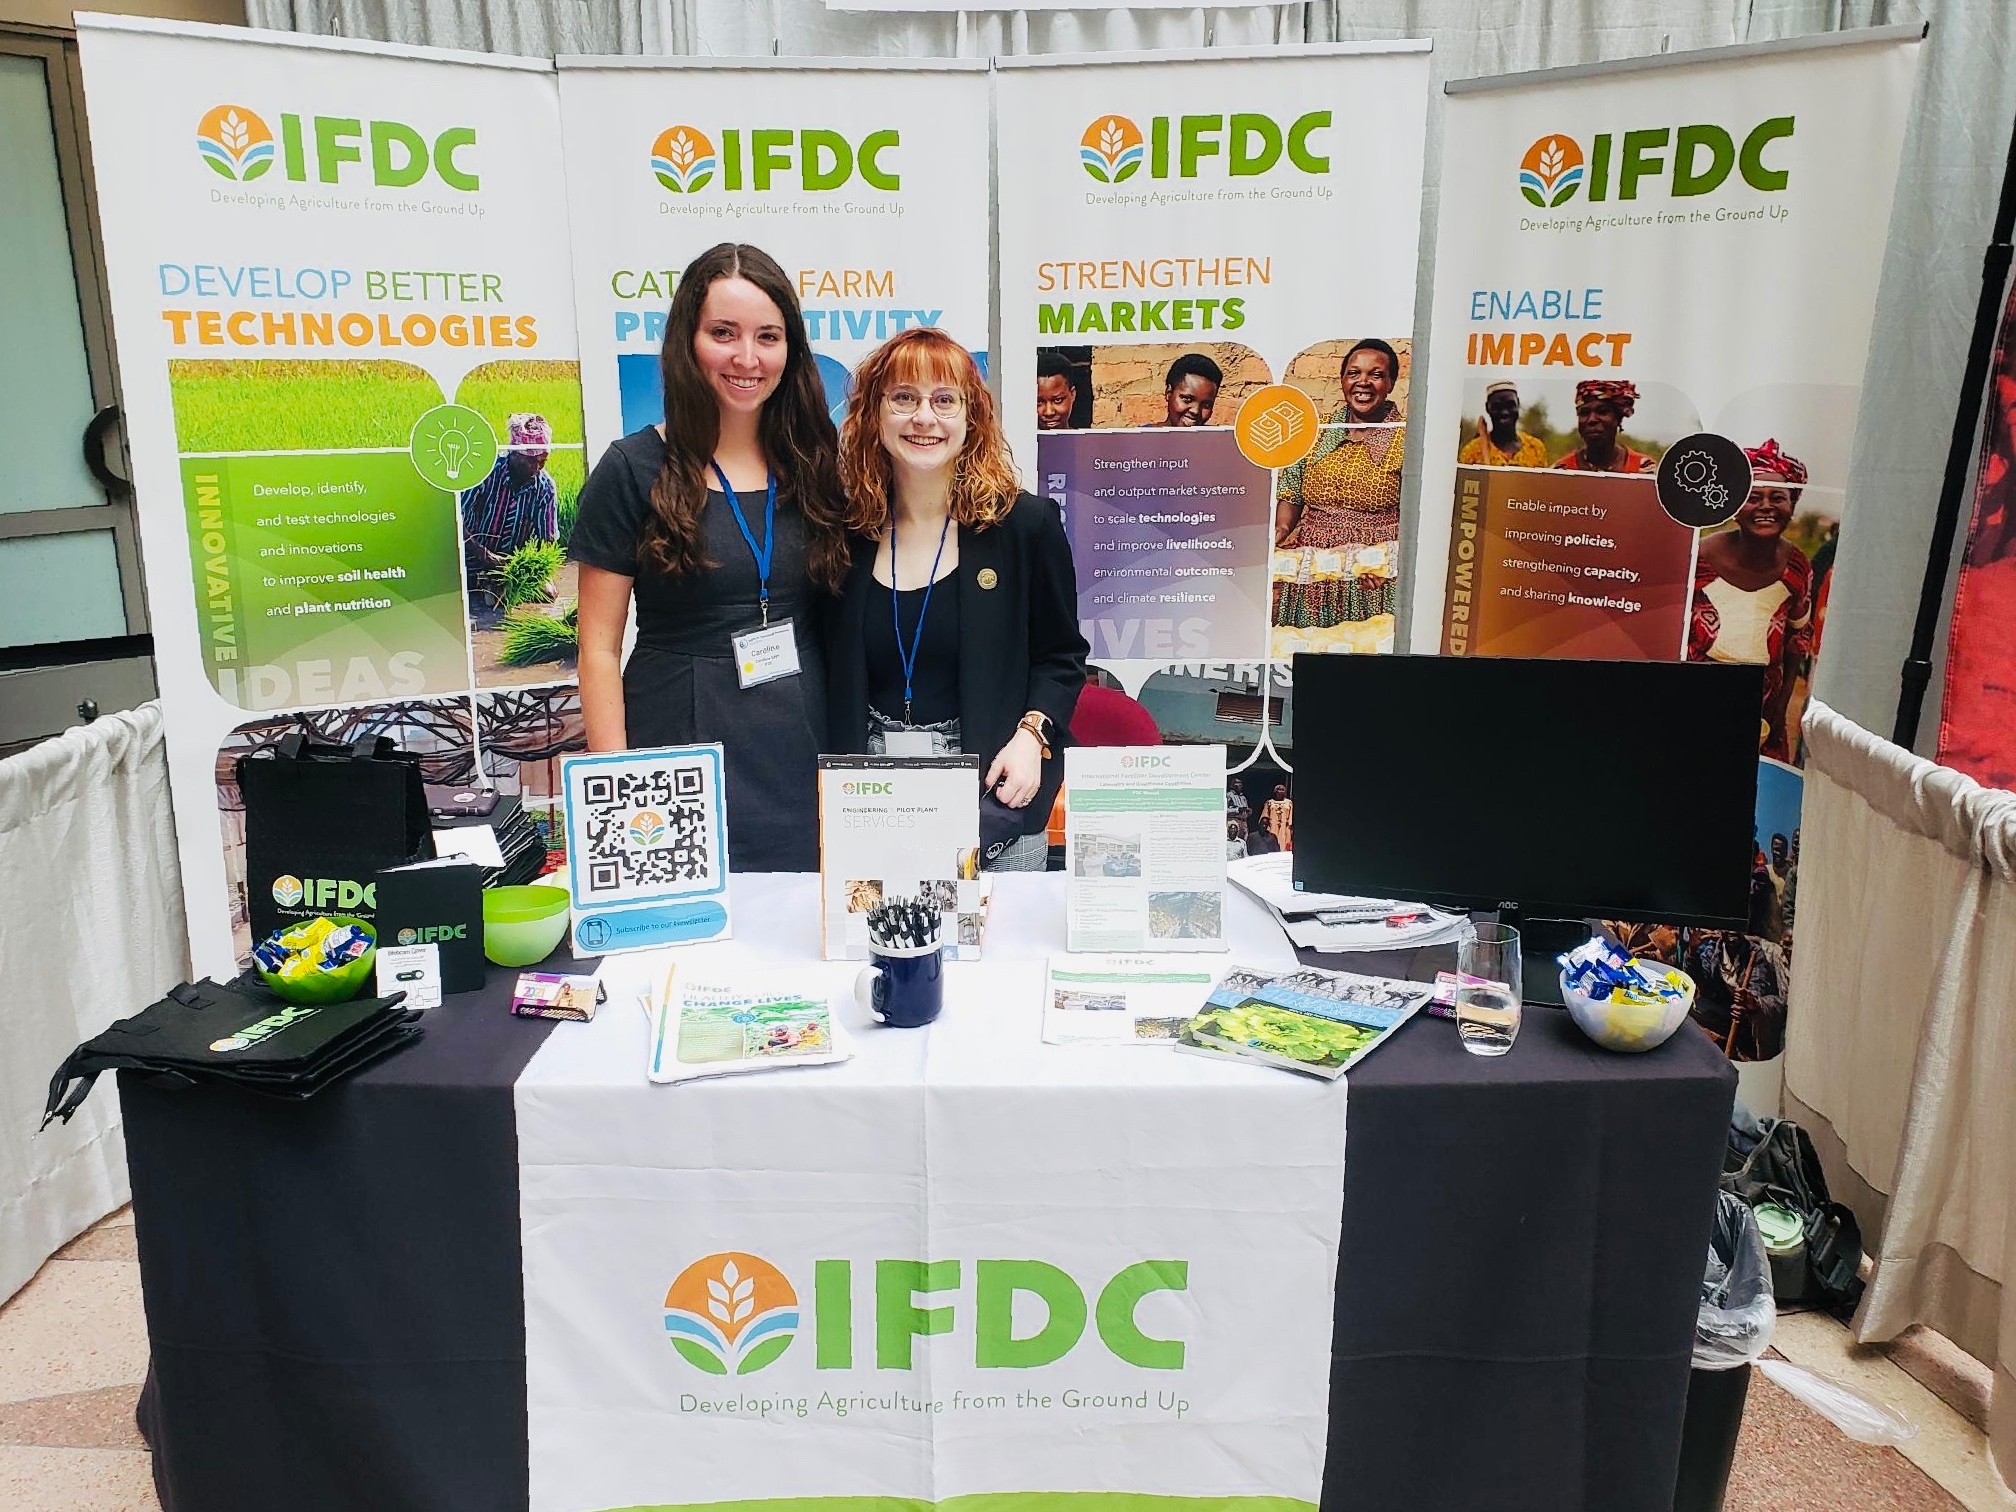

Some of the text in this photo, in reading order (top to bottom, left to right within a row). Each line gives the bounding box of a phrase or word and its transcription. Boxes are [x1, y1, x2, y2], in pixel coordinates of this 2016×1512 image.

[280, 112, 481, 192] IFDC
[1151, 110, 1333, 179] IFDC
[721, 129, 901, 191] IFDC
[1588, 115, 1796, 202] IFDC
[210, 189, 486, 220] Developing Agriculture from the Ground Up
[1085, 186, 1333, 207] Developing Agriculture from the Ground Up
[659, 202, 905, 218] Developing Agriculture from the Ground Up
[1519, 204, 1789, 233] Developing Agriculture from the Ground Up
[158, 263, 504, 302] DEVELOP BETTER
[799, 269, 895, 298] FARM
[1037, 256, 1272, 291] STRENGTHEN
[1038, 297, 1246, 334] MARKETS
[1471, 288, 1603, 321] ENABLE
[162, 309, 539, 348] TECHNOLOGIES
[1466, 331, 1632, 367] IMPACT
[1094, 457, 1189, 473] Strengthen input
[253, 479, 367, 498] Develop, identify,
[1094, 484, 1246, 499] and output market systems
[256, 508, 396, 527] and test technologies
[1094, 511, 1216, 527] to scale technologies
[1507, 498, 1607, 520] Enable impact by
[260, 541, 363, 557] and innovations
[1094, 537, 1236, 554] and improve livelihoods,
[1504, 528, 1618, 550] improving policies,
[194, 474, 239, 662] INNOVATIVE
[263, 566, 406, 589] to improve soil health
[1094, 566, 1237, 579] environmental outcomes,
[1450, 480, 1480, 656] EMPOWERED
[1502, 557, 1641, 583] strengthening capacity,
[266, 597, 392, 618] and plant nutrition
[1094, 592, 1216, 604] and climate resilience
[1500, 586, 1642, 613] and sharing knowledge
[1080, 617, 1213, 659] IVES
[751, 645, 780, 657] Caroline
[218, 650, 427, 712] IDEAS
[1135, 755, 1172, 769] IFDC
[856, 782, 893, 795] IFDC
[843, 814, 916, 829] SERVICES
[277, 908, 305, 917] Developing
[1498, 901, 1519, 910] AOC
[417, 923, 467, 943] IFDC
[616, 923, 650, 935] Subscribe
[651, 922, 660, 930] to
[660, 921, 673, 929] our
[757, 994, 802, 1004] LIVES
[814, 1259, 1189, 1371] IFDC
[680, 1388, 1190, 1420] Developing Agriculture from the Ground Up
